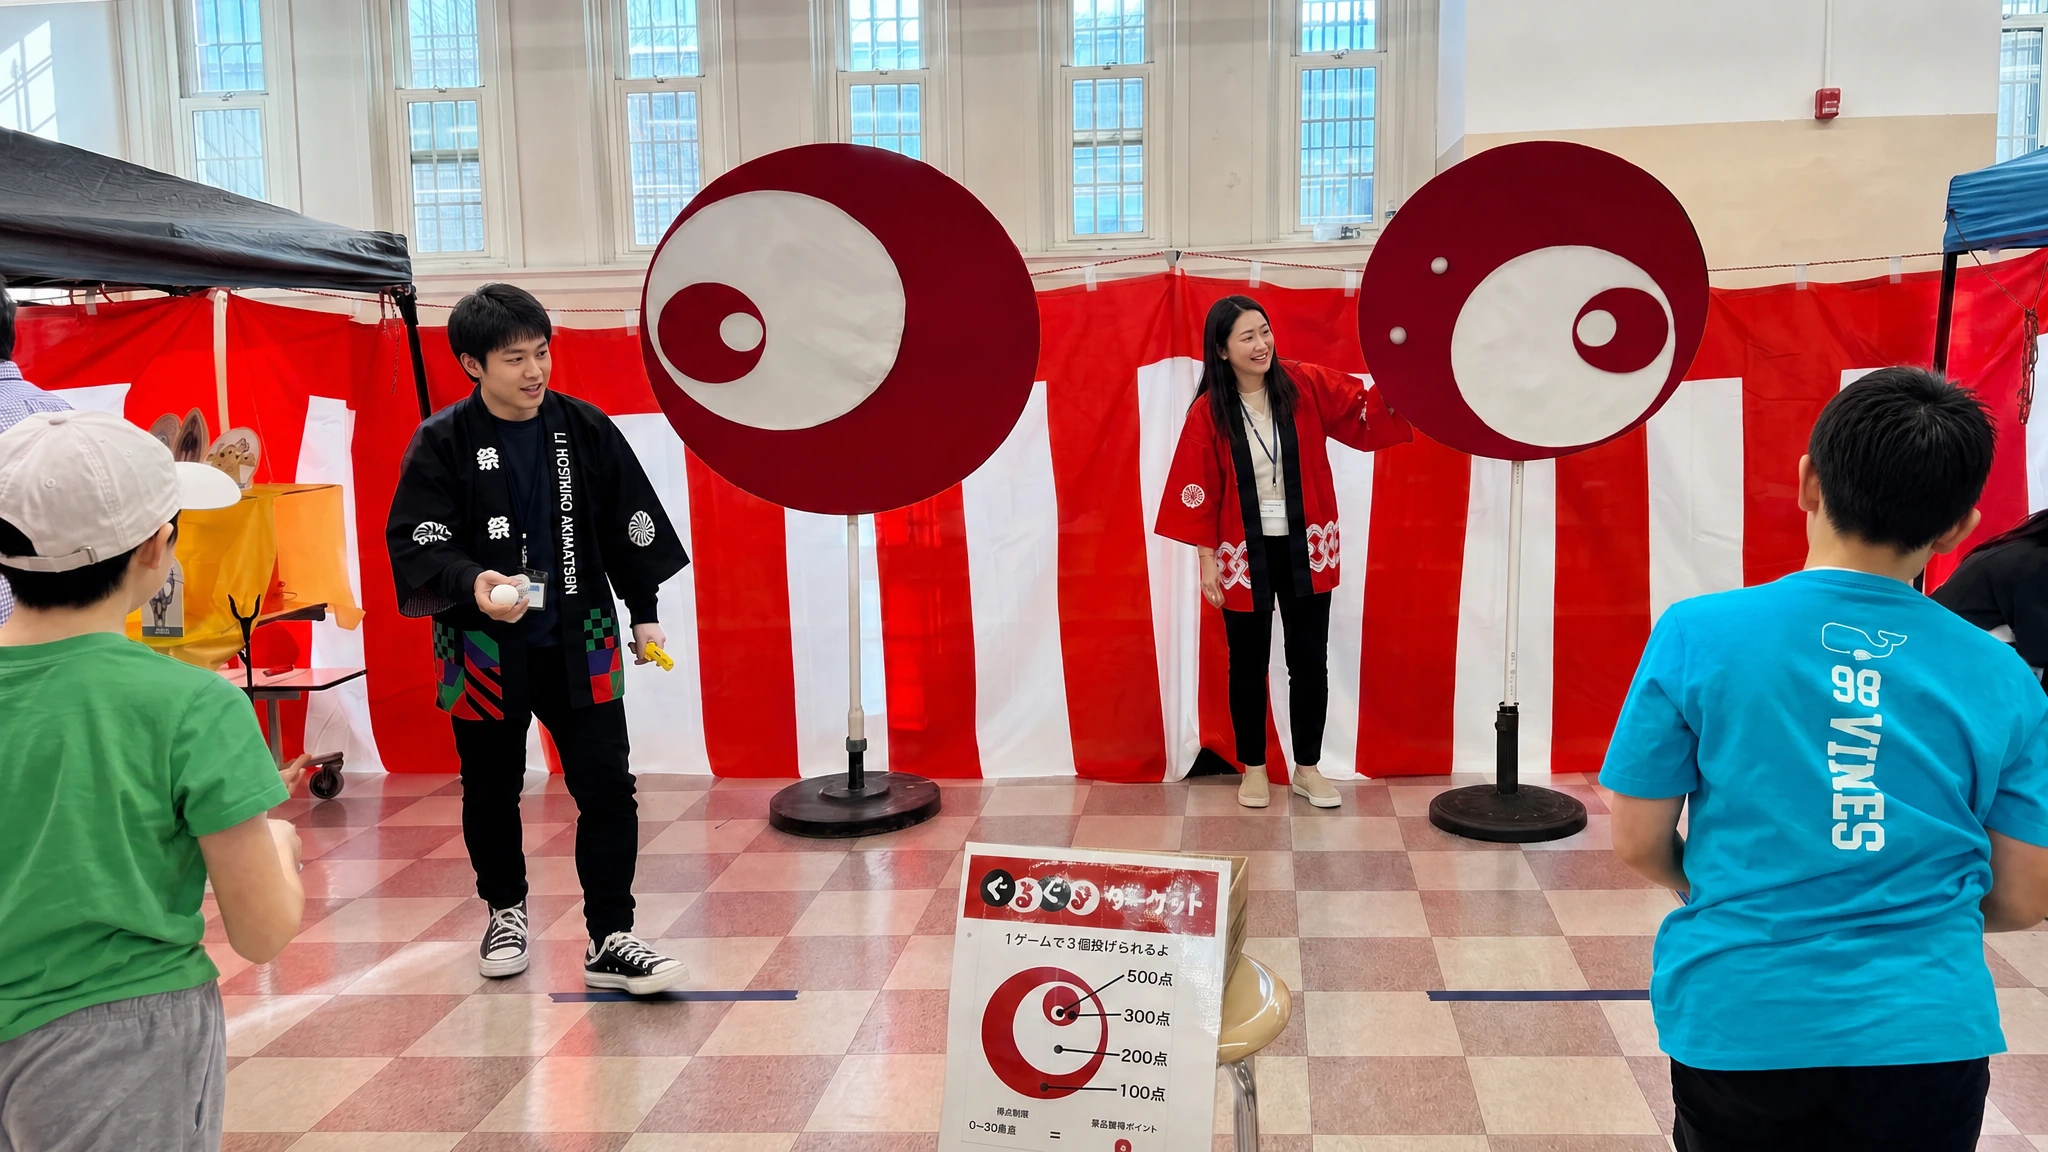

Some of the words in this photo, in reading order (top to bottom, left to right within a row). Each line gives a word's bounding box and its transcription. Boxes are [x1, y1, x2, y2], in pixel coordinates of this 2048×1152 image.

[476, 446, 500, 471] 祭
[487, 515, 511, 540] 祭
[1831, 664, 1882, 708] 98
[1127, 969, 1173, 987] 500点
[1123, 1008, 1171, 1027] 300点
[1121, 1048, 1168, 1067] 200点
[1120, 1083, 1166, 1102] 100点
